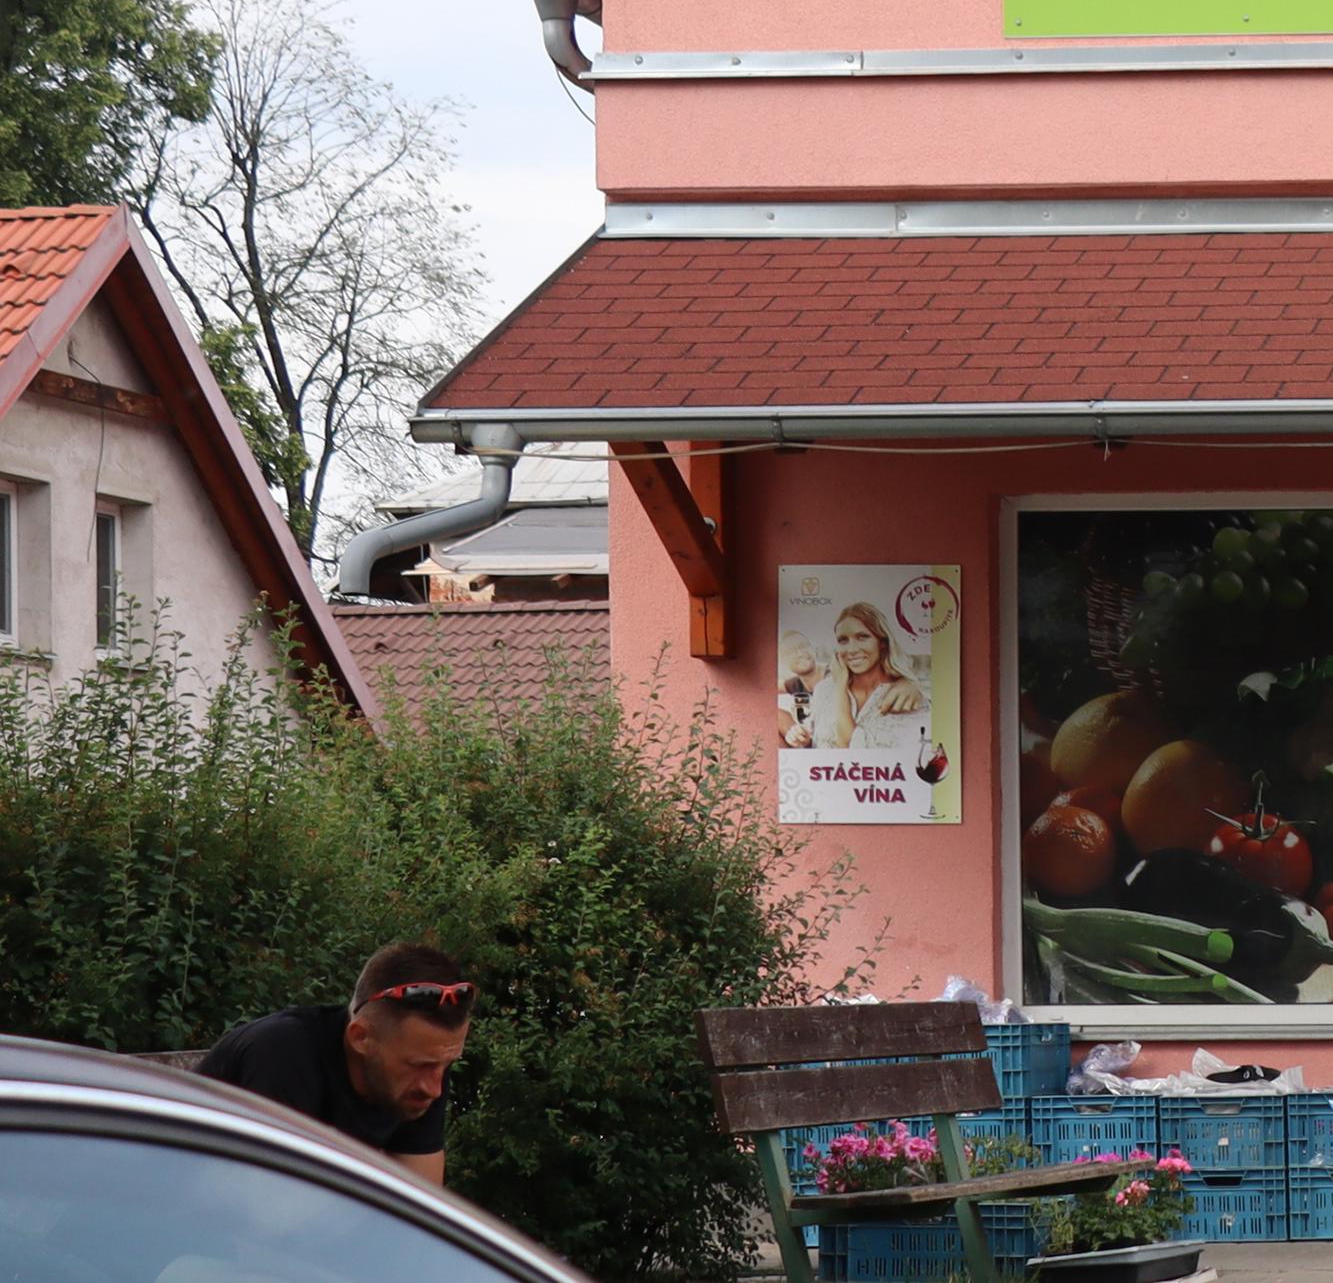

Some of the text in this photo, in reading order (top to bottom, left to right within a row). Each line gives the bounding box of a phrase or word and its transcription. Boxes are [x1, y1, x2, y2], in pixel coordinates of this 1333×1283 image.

[906, 583, 931, 601] ZDE
[809, 761, 906, 781] STÁČENÁ
[854, 784, 906, 804] VÍNA
